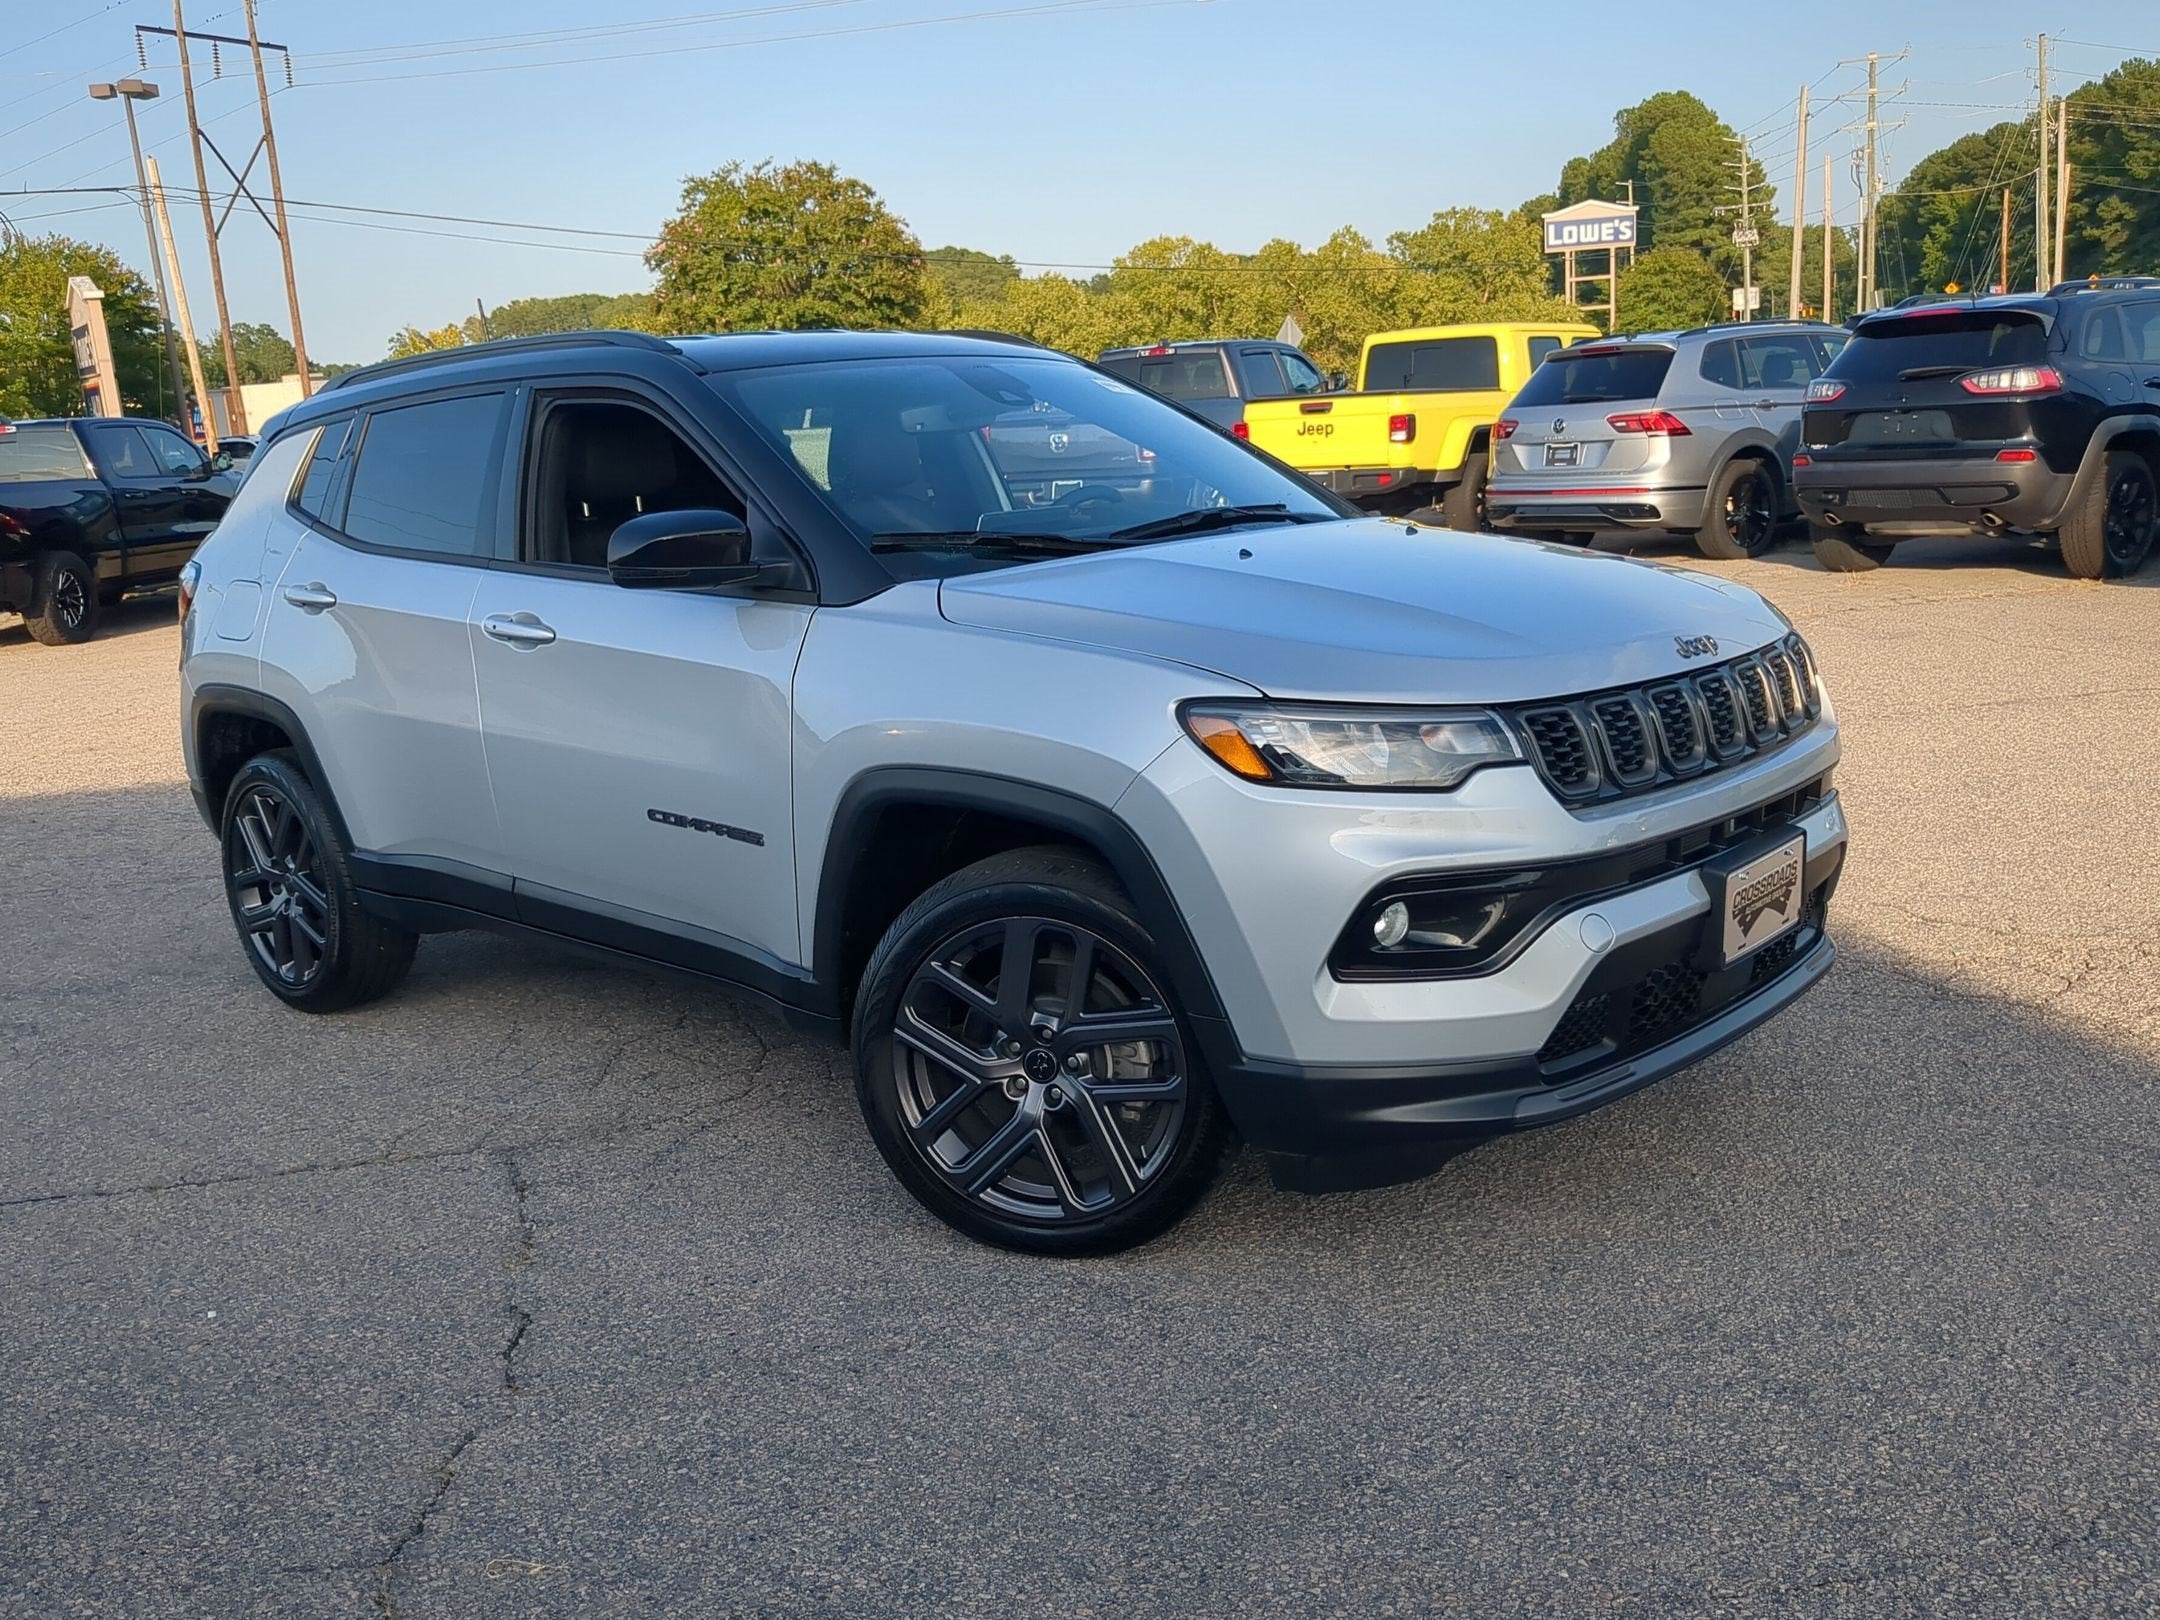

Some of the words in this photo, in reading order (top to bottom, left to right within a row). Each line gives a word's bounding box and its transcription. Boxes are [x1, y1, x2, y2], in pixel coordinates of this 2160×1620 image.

[1548, 218, 1632, 245] LOWE'S
[1297, 421, 1334, 438] Jeep
[1674, 635, 1718, 659] Jeep
[647, 809, 765, 846] COMPASS
[1733, 860, 1798, 909] CROSSROADS
